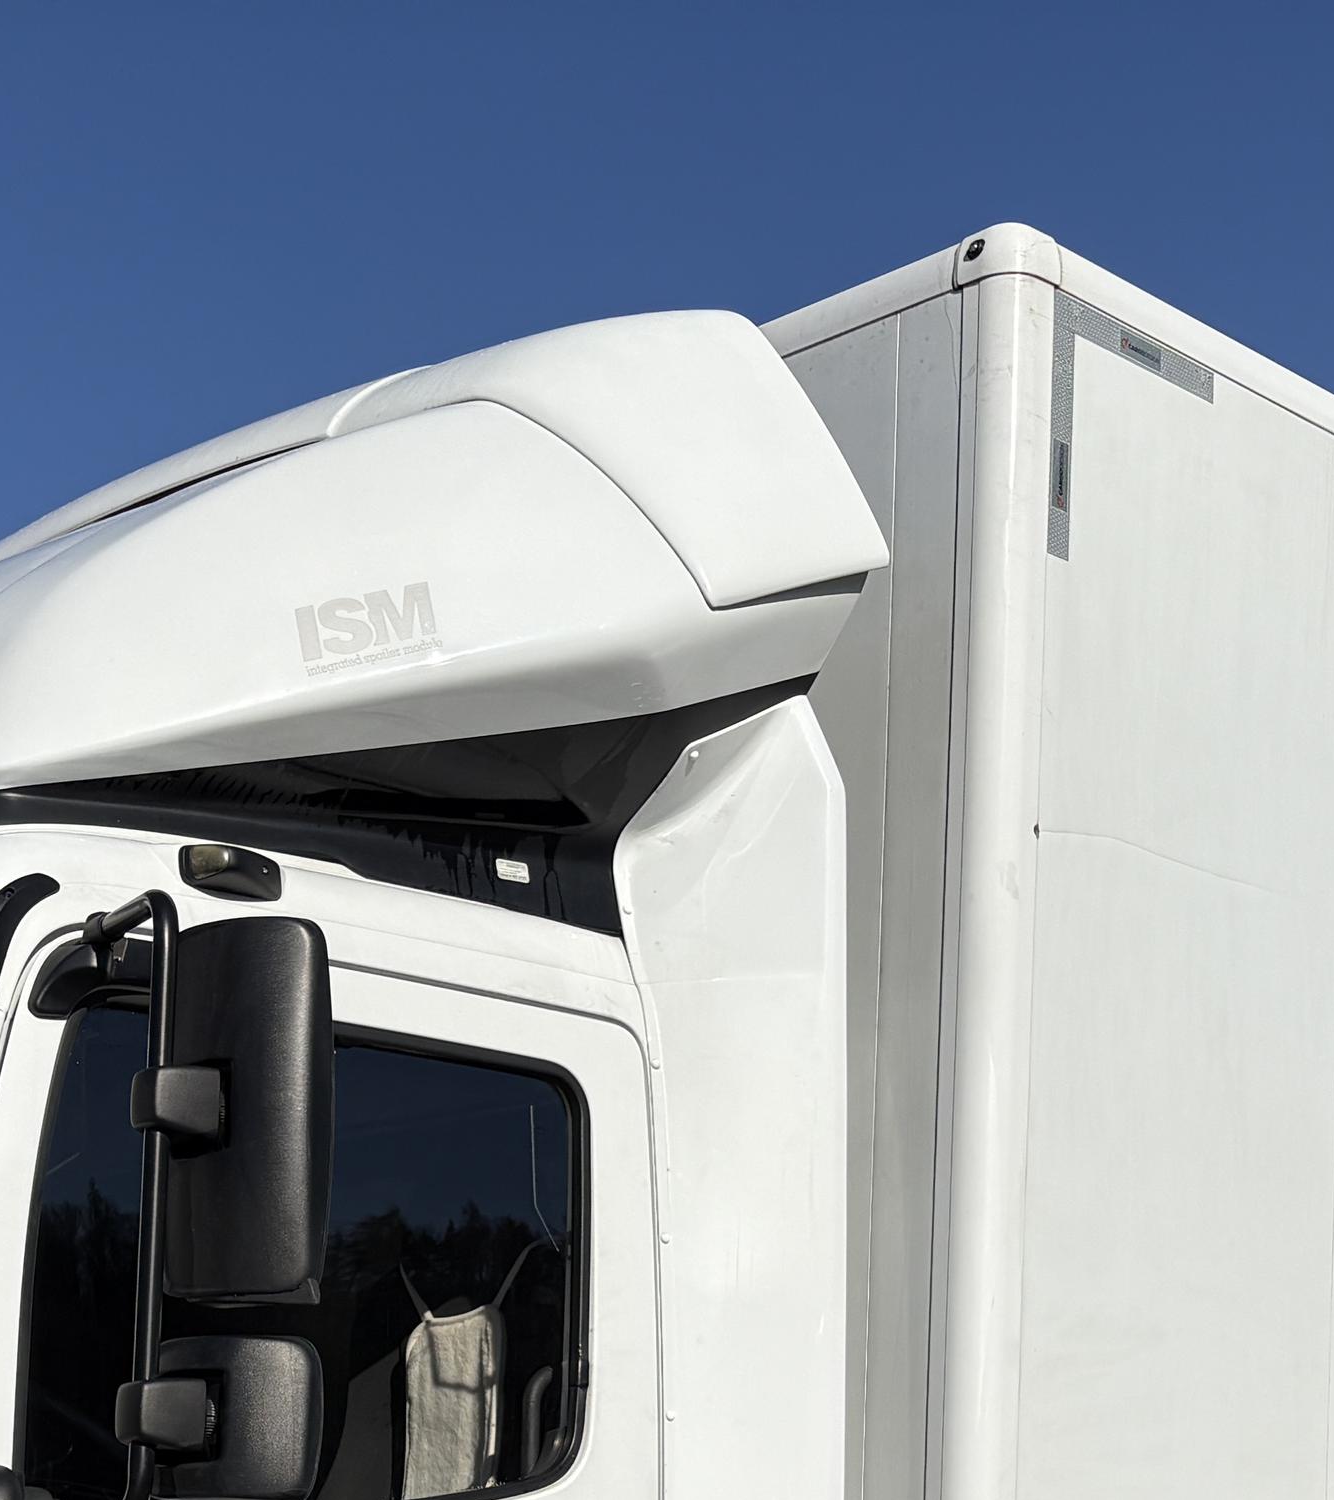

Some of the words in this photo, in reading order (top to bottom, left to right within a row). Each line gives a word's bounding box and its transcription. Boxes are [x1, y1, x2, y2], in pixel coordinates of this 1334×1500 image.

[295, 581, 436, 662] ISM
[305, 654, 363, 677] integrated
[363, 647, 401, 665] spoiler
